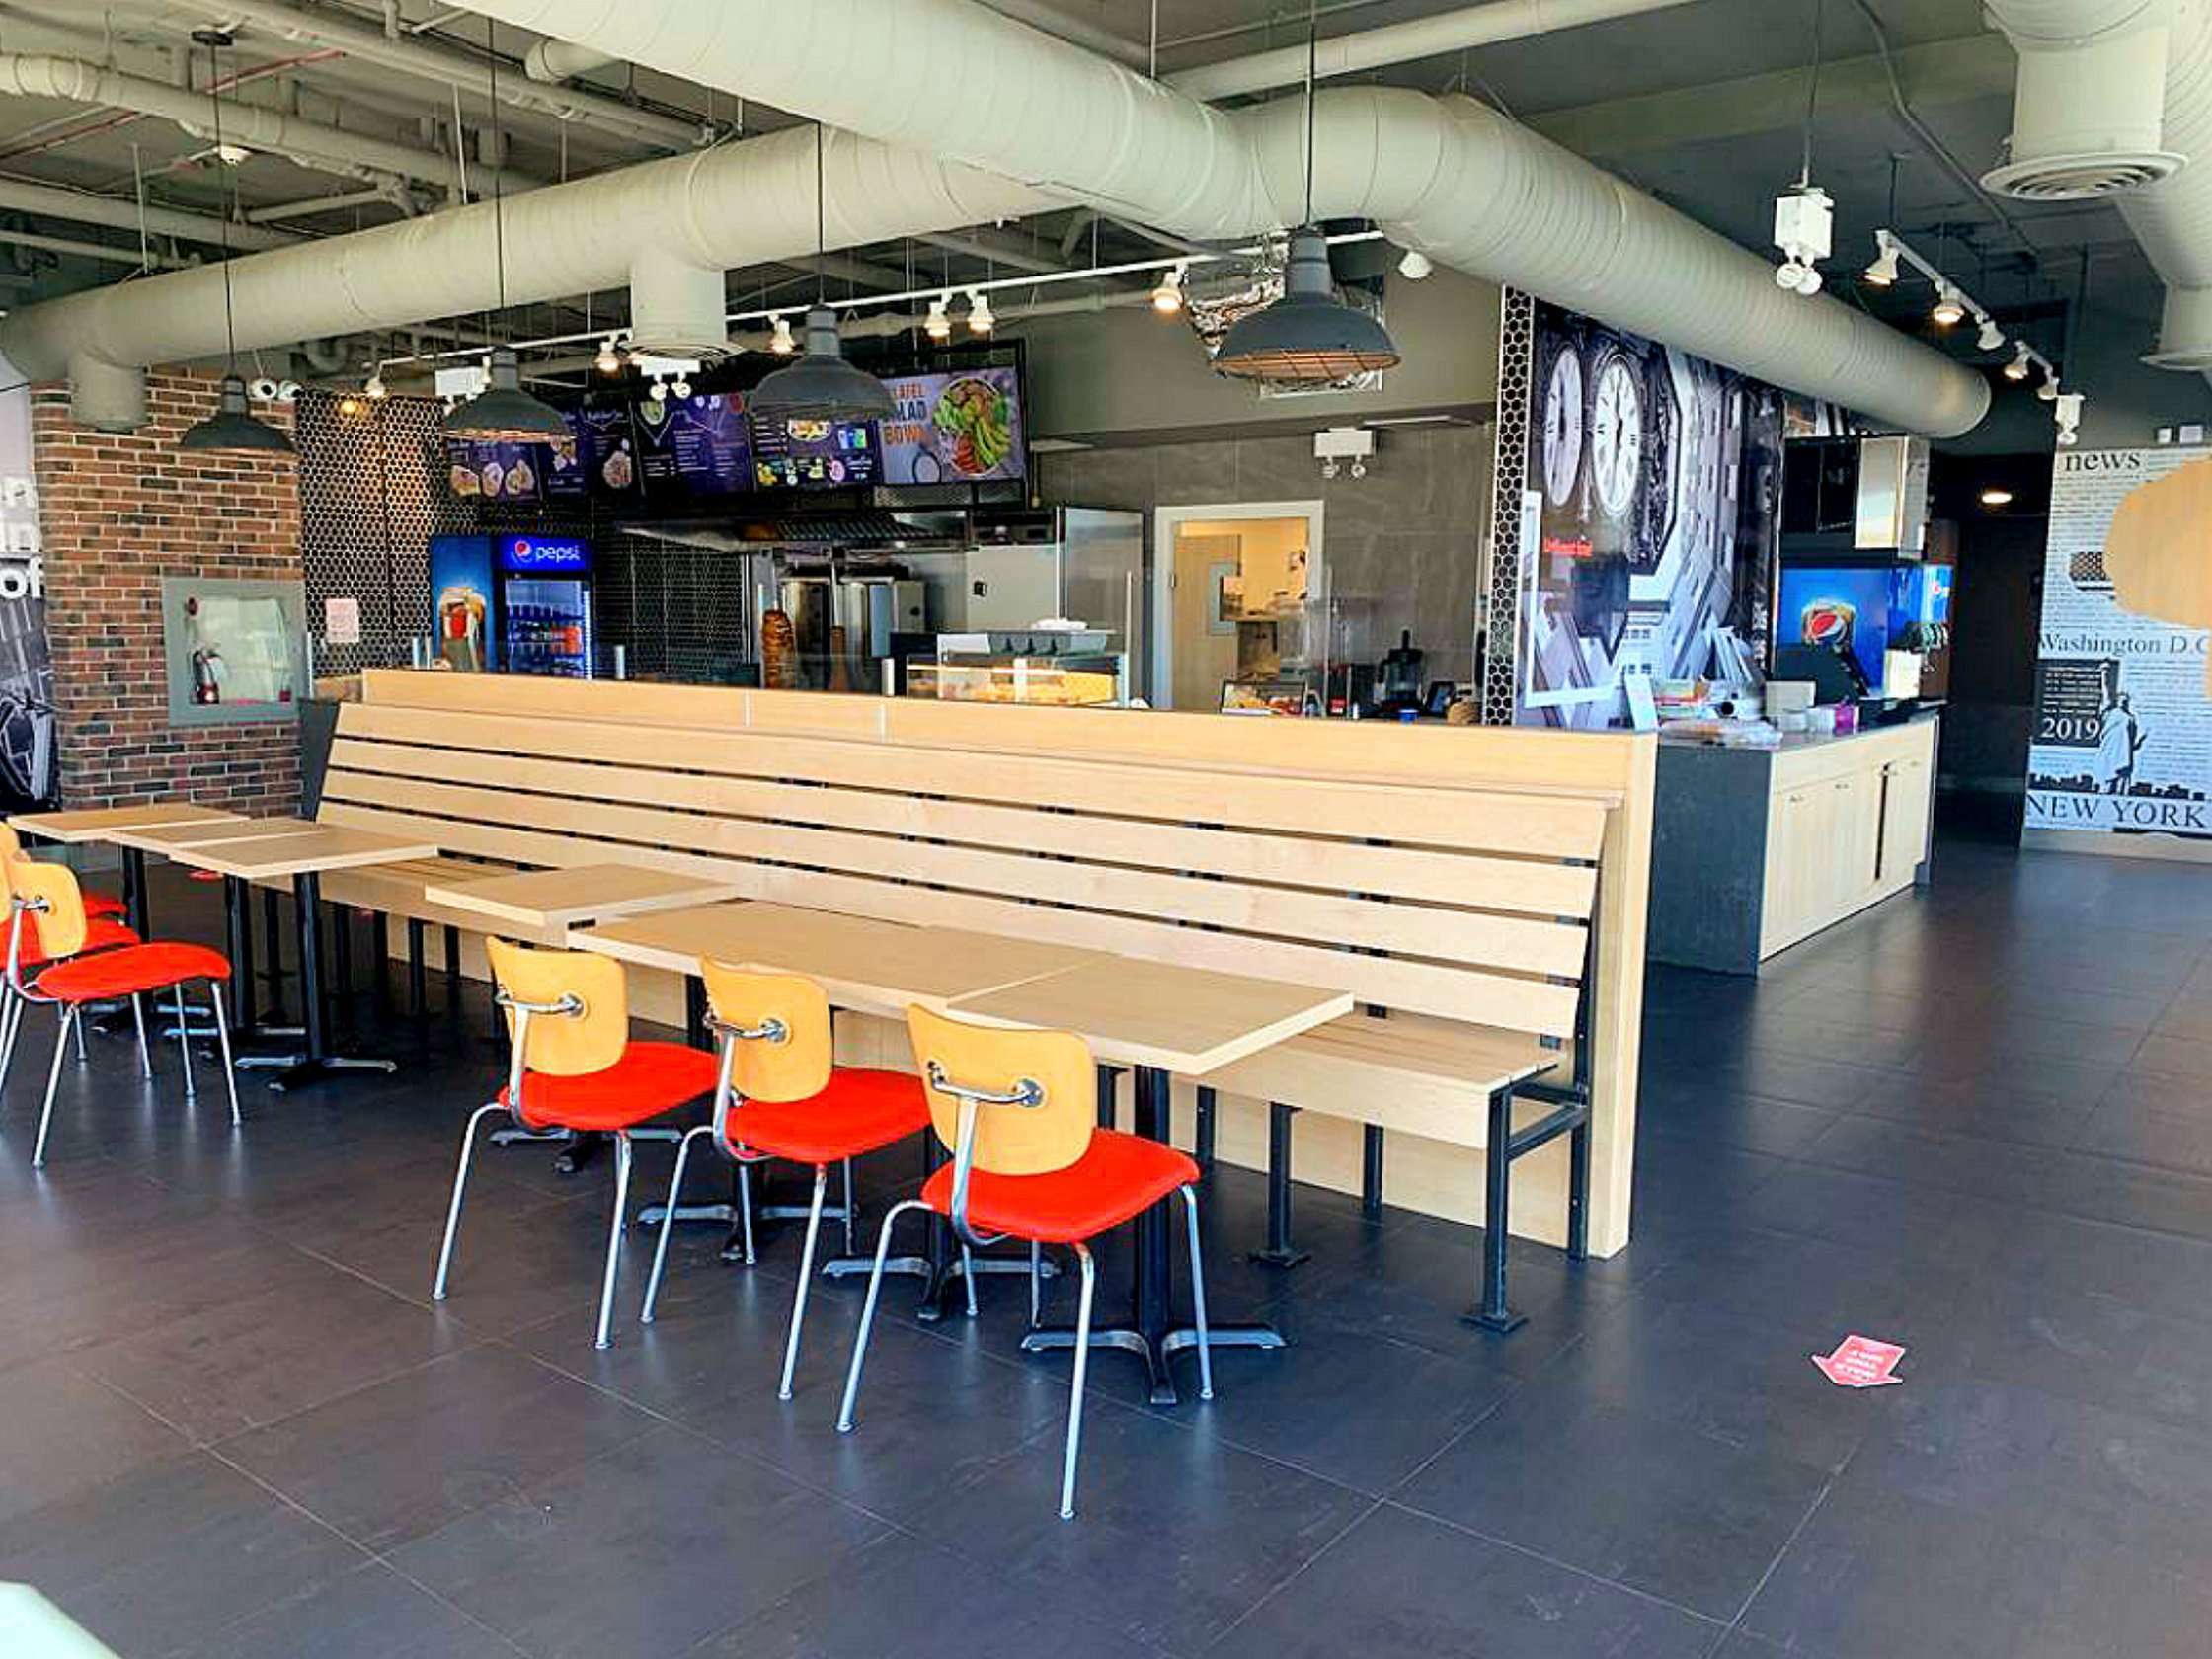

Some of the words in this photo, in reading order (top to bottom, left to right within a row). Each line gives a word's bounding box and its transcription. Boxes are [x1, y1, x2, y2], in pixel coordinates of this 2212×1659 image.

[2065, 451, 2141, 471] news
[535, 545, 580, 563] pepsi
[2041, 632, 2161, 657] Washington
[2039, 717, 2101, 741] 2019
[2026, 794, 2101, 820] NEW
[2112, 800, 2205, 828] YORK
